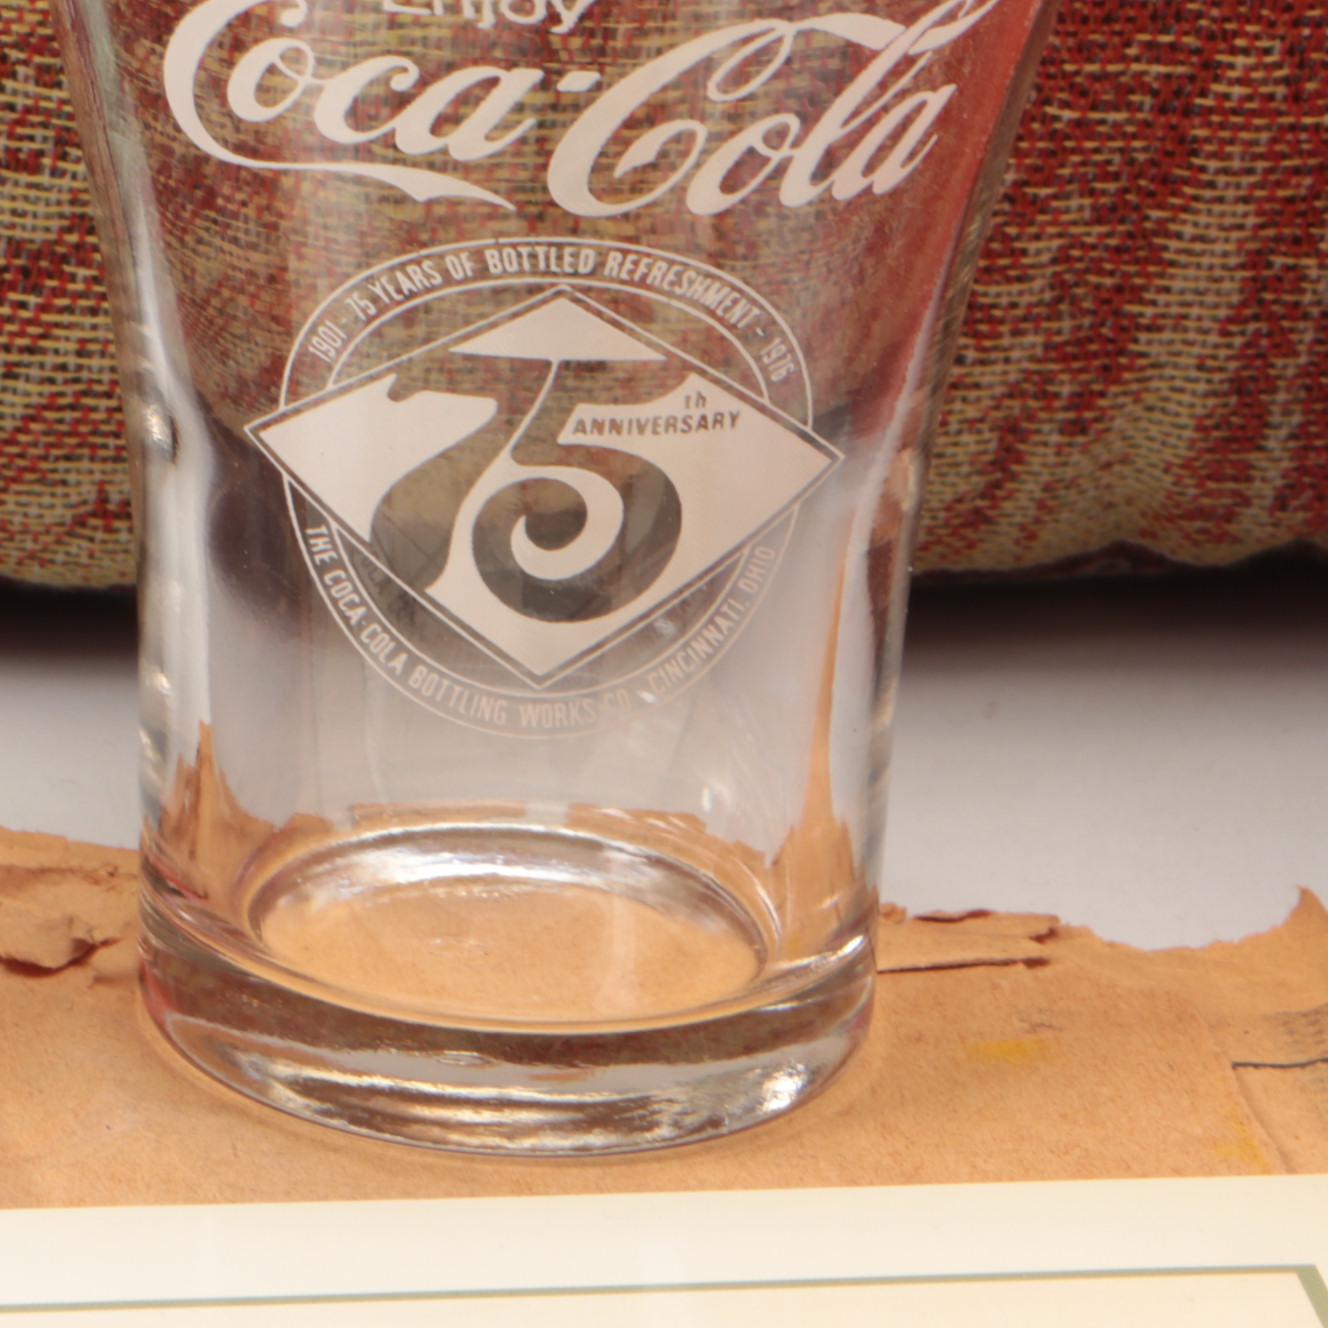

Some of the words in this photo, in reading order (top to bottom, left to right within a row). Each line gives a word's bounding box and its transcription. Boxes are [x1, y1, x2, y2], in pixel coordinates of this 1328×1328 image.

[306, 323, 347, 364] 1901
[372, 258, 443, 310] YEARS
[445, 253, 475, 281] OF
[486, 244, 597, 274] BOTTLED
[603, 250, 762, 330] REFRESHMENT
[760, 337, 797, 382] 1976
[570, 407, 742, 437] ANNIVERSARY
[303, 522, 327, 566] THE
[323, 567, 409, 677] COCA-COLA
[407, 663, 508, 727] BOTTLING
[518, 696, 599, 729] WORKS
[743, 543, 777, 592] OHIO
